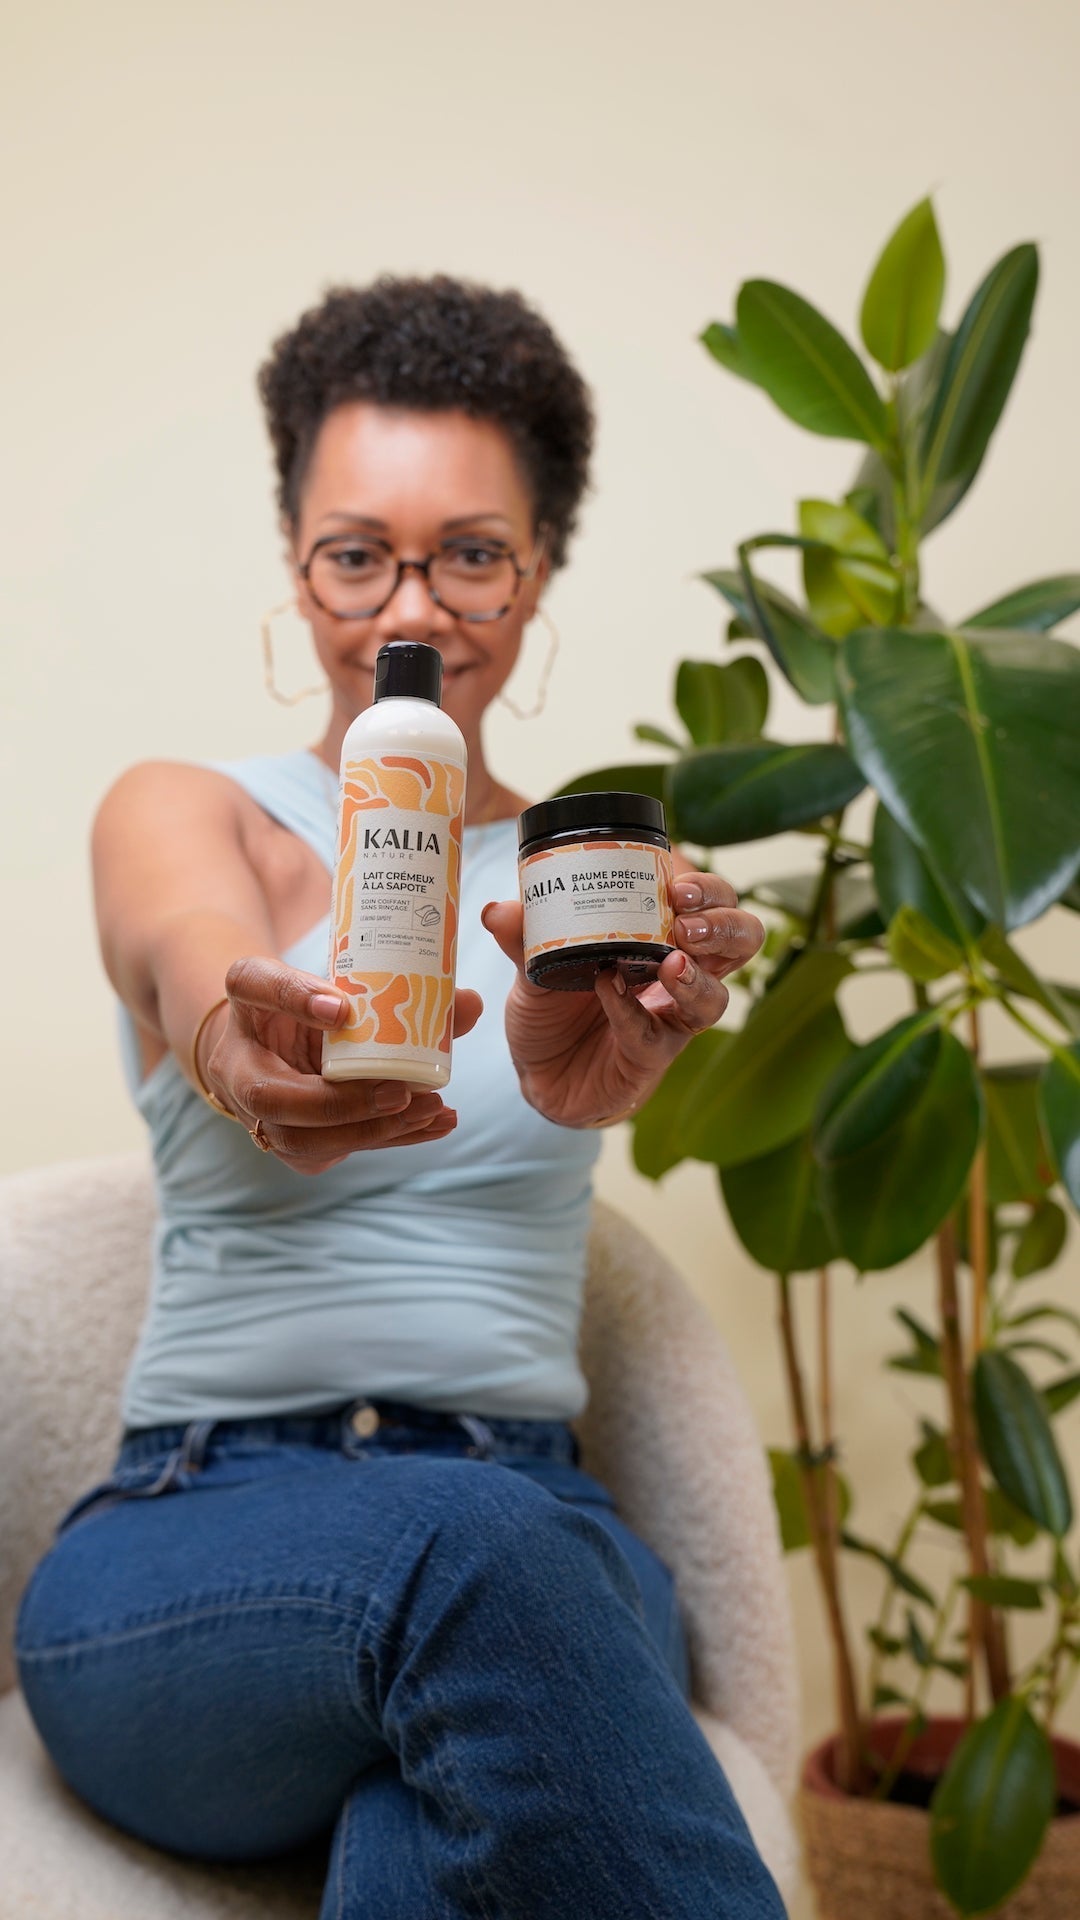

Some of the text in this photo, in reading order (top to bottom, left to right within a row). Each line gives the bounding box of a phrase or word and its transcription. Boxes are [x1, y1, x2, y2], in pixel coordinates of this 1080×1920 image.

[364, 828, 440, 855] KALIA
[363, 852, 414, 860] NATURE
[363, 871, 435, 884] LAIT CRÉMEUX
[571, 869, 655, 882] BAUME PRÉCIEUX
[362, 881, 427, 893] À LA SAPOTE
[525, 877, 566, 904] KALIA
[572, 881, 635, 892] À LA SAPOTE
[378, 904, 408, 912] RINÇAGE
[418, 948, 439, 958] 250ml
